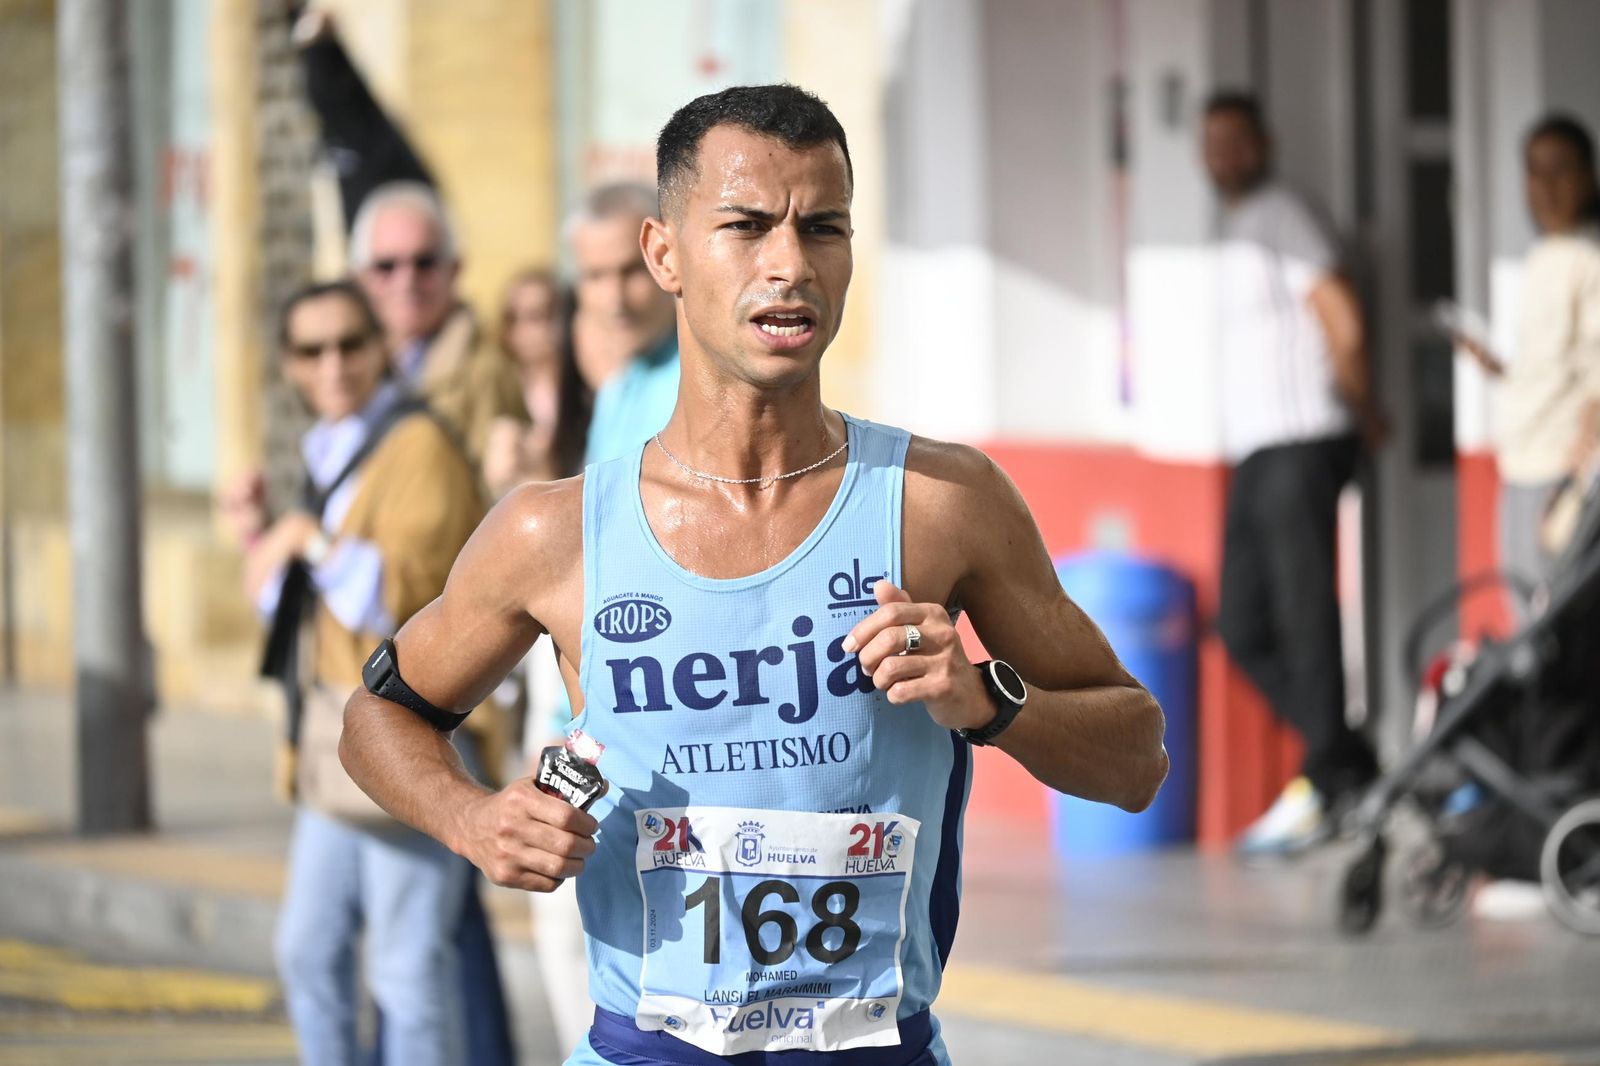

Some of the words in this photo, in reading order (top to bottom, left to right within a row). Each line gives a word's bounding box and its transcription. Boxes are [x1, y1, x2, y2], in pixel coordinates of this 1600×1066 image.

[603, 592, 633, 604] AGUACATE
[641, 592, 664, 602] MANGO
[598, 602, 668, 634] TROPS
[831, 610, 857, 618] sport
[606, 615, 876, 724] nerja
[661, 732, 851, 774] ATLETISMO
[540, 757, 599, 809] Energy
[769, 845, 809, 853] Ayuntamiento
[653, 851, 706, 868] HUELVA
[767, 853, 817, 864] HUELVA
[845, 858, 896, 873] HUELVA
[685, 876, 862, 966] 168
[746, 970, 798, 982] MOHAMED
[704, 989, 743, 1003] LANSI
[747, 991, 760, 1003] EL
[764, 982, 832, 999] MARAIMIMI
[710, 1001, 813, 1033] Huelva
[771, 1033, 813, 1044] original
